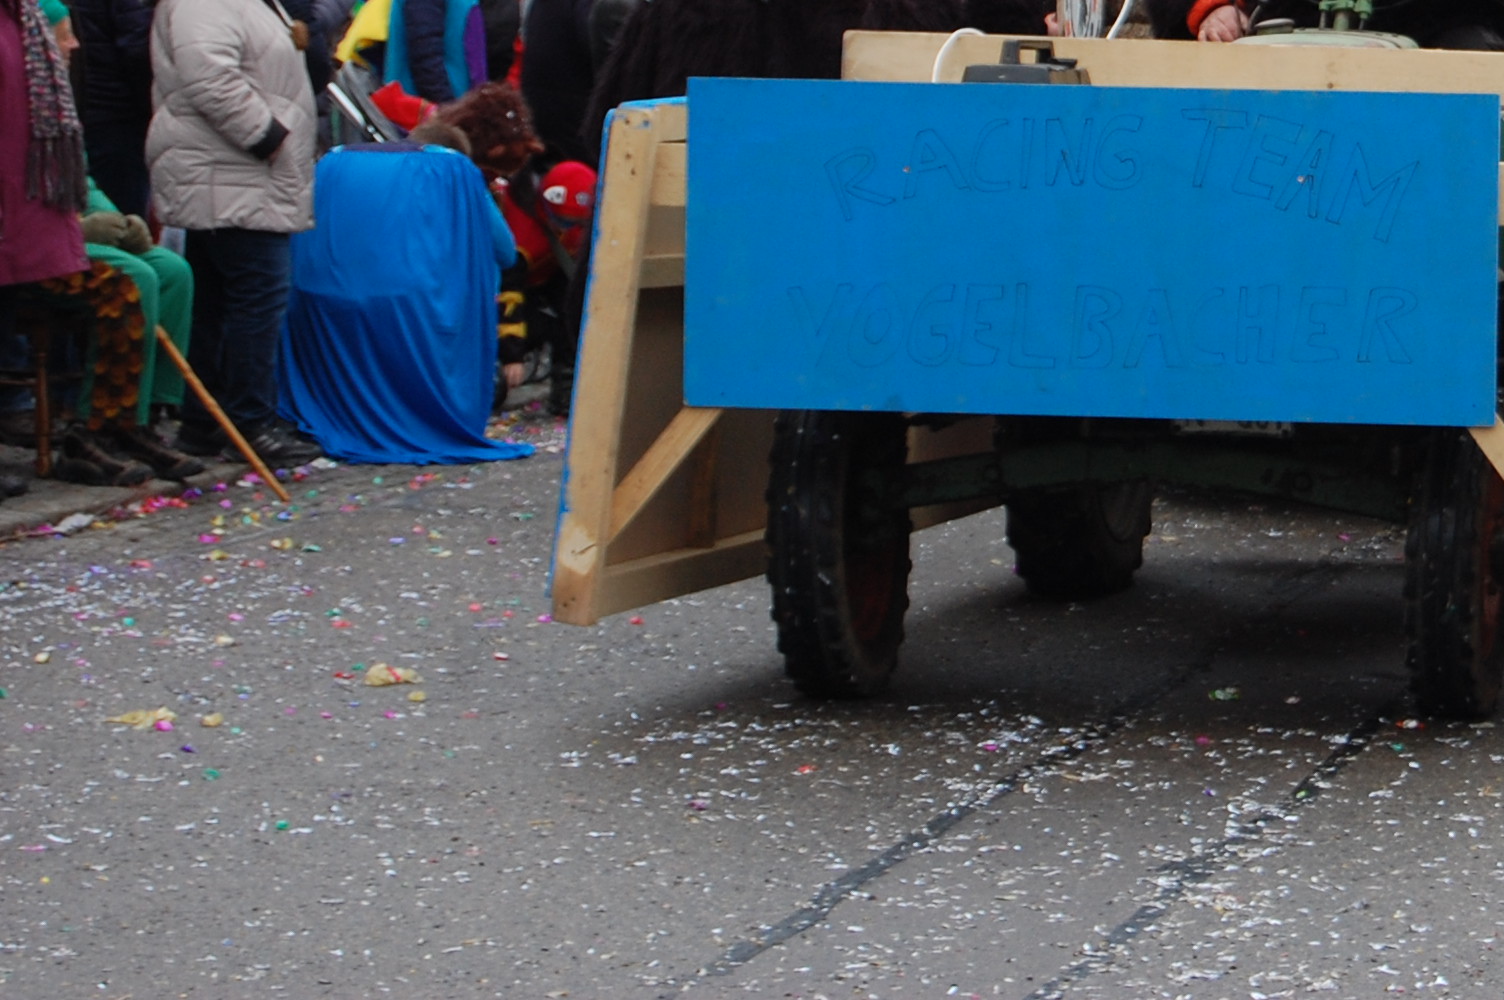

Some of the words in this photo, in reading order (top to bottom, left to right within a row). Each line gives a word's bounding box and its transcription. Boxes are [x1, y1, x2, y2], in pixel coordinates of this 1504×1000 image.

[824, 113, 1144, 222] RACING
[1180, 108, 1420, 243] TEAM
[786, 281, 1418, 369] VOGELBACHER
